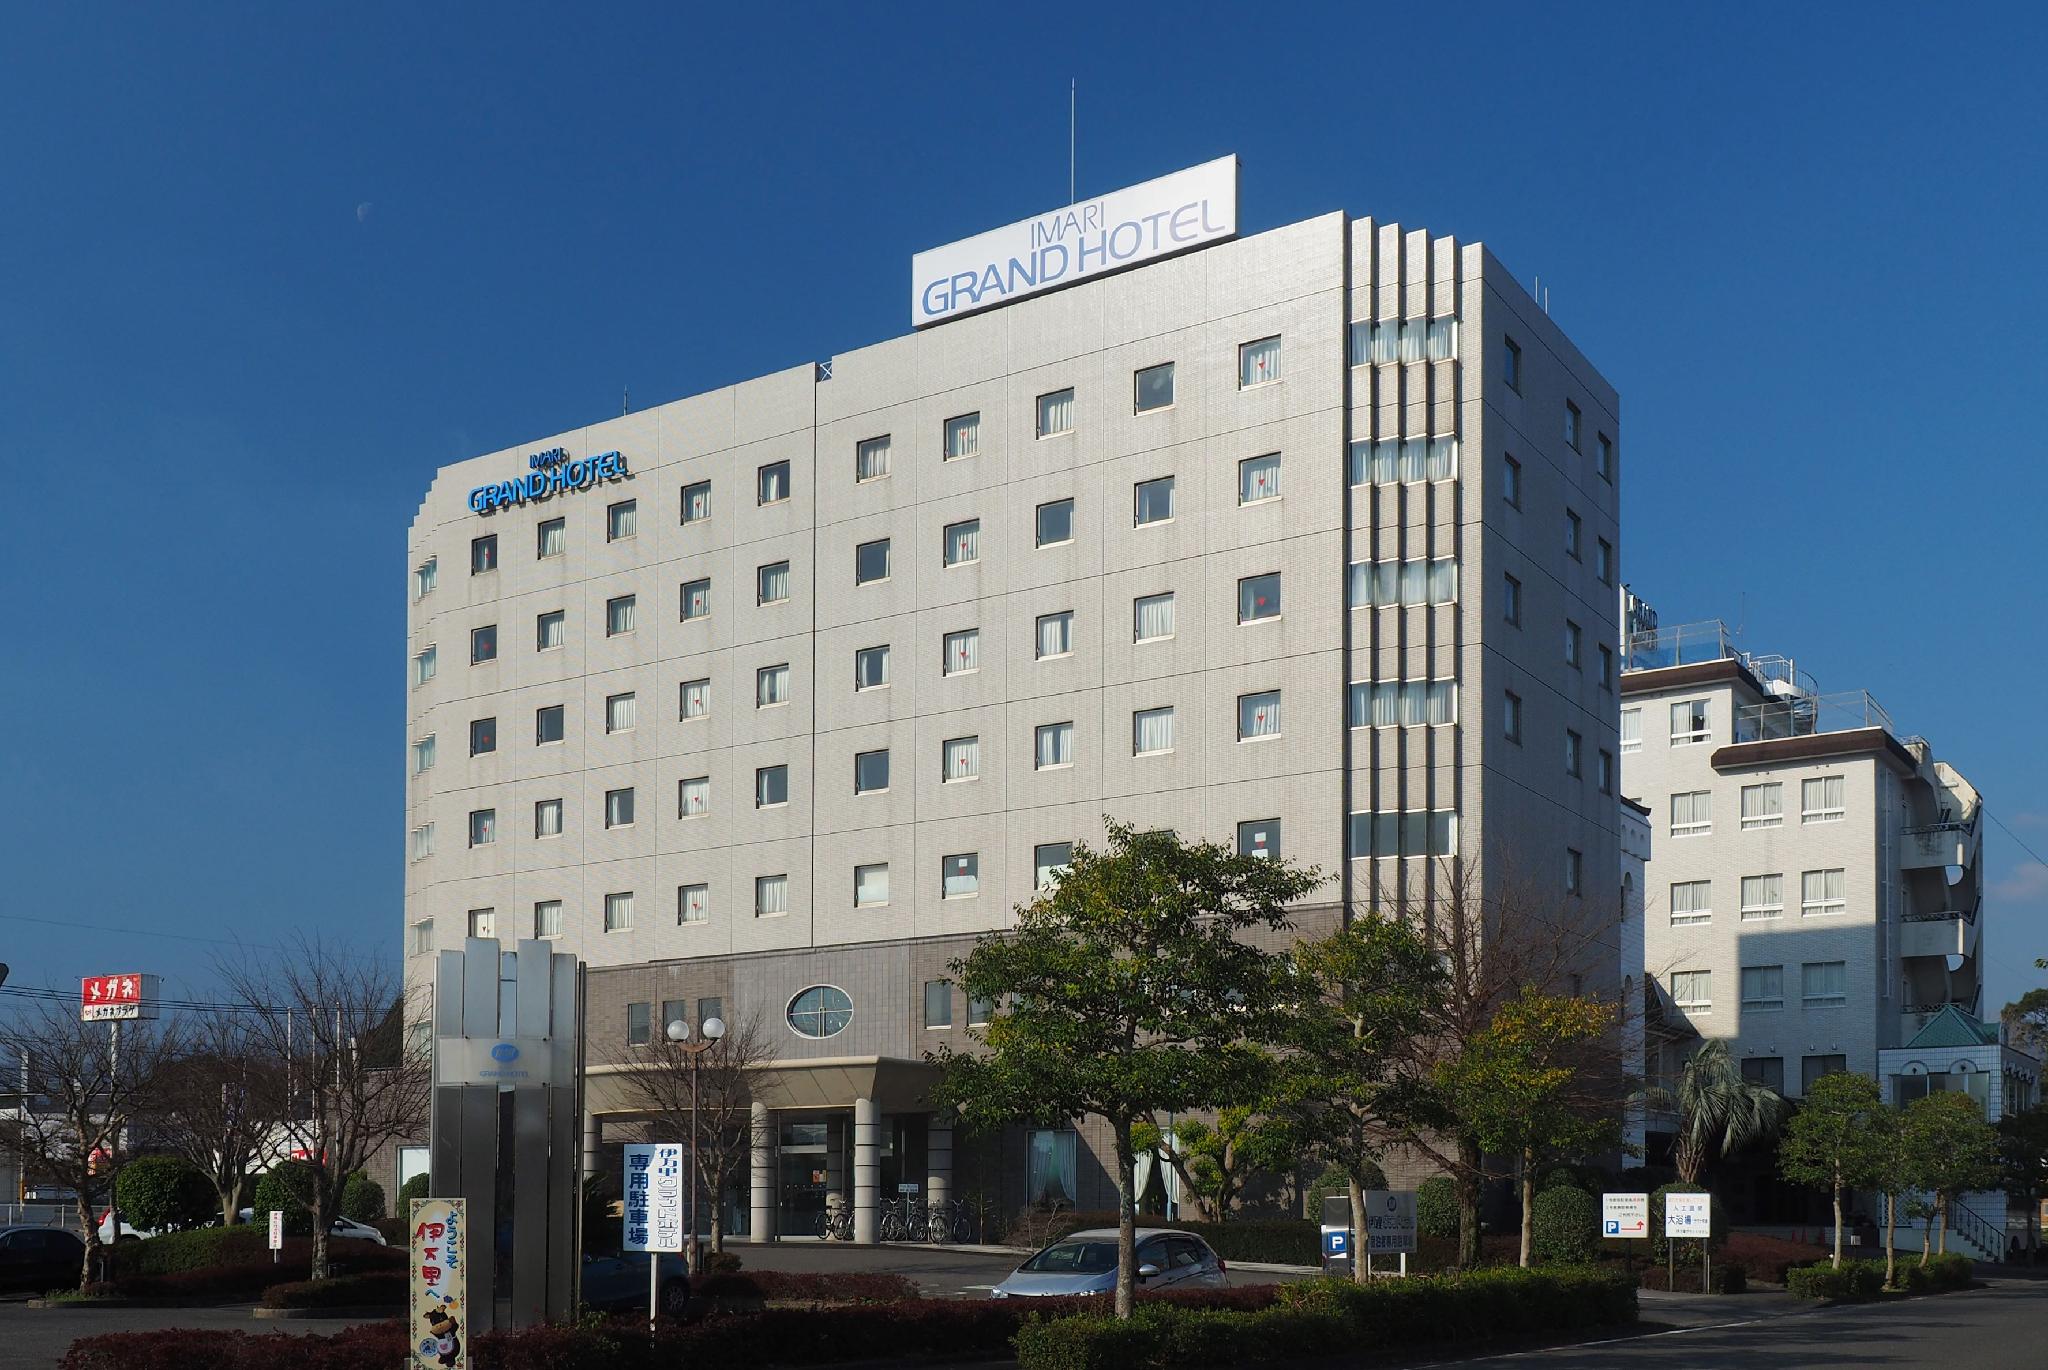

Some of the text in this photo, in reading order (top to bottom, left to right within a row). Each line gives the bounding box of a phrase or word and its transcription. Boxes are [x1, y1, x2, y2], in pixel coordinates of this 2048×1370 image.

[1030, 201, 1104, 249] IMARI
[921, 199, 1226, 315] GRAND HOTEL
[468, 450, 626, 513] GRAND HOTEL
[529, 448, 564, 468] IMARI
[90, 978, 134, 1001] メガネ
[629, 1153, 649, 1245] 専用駐車場
[446, 1210, 458, 1269] ようこそ
[1332, 1236, 1344, 1249] P
[1608, 1222, 1617, 1232] P
